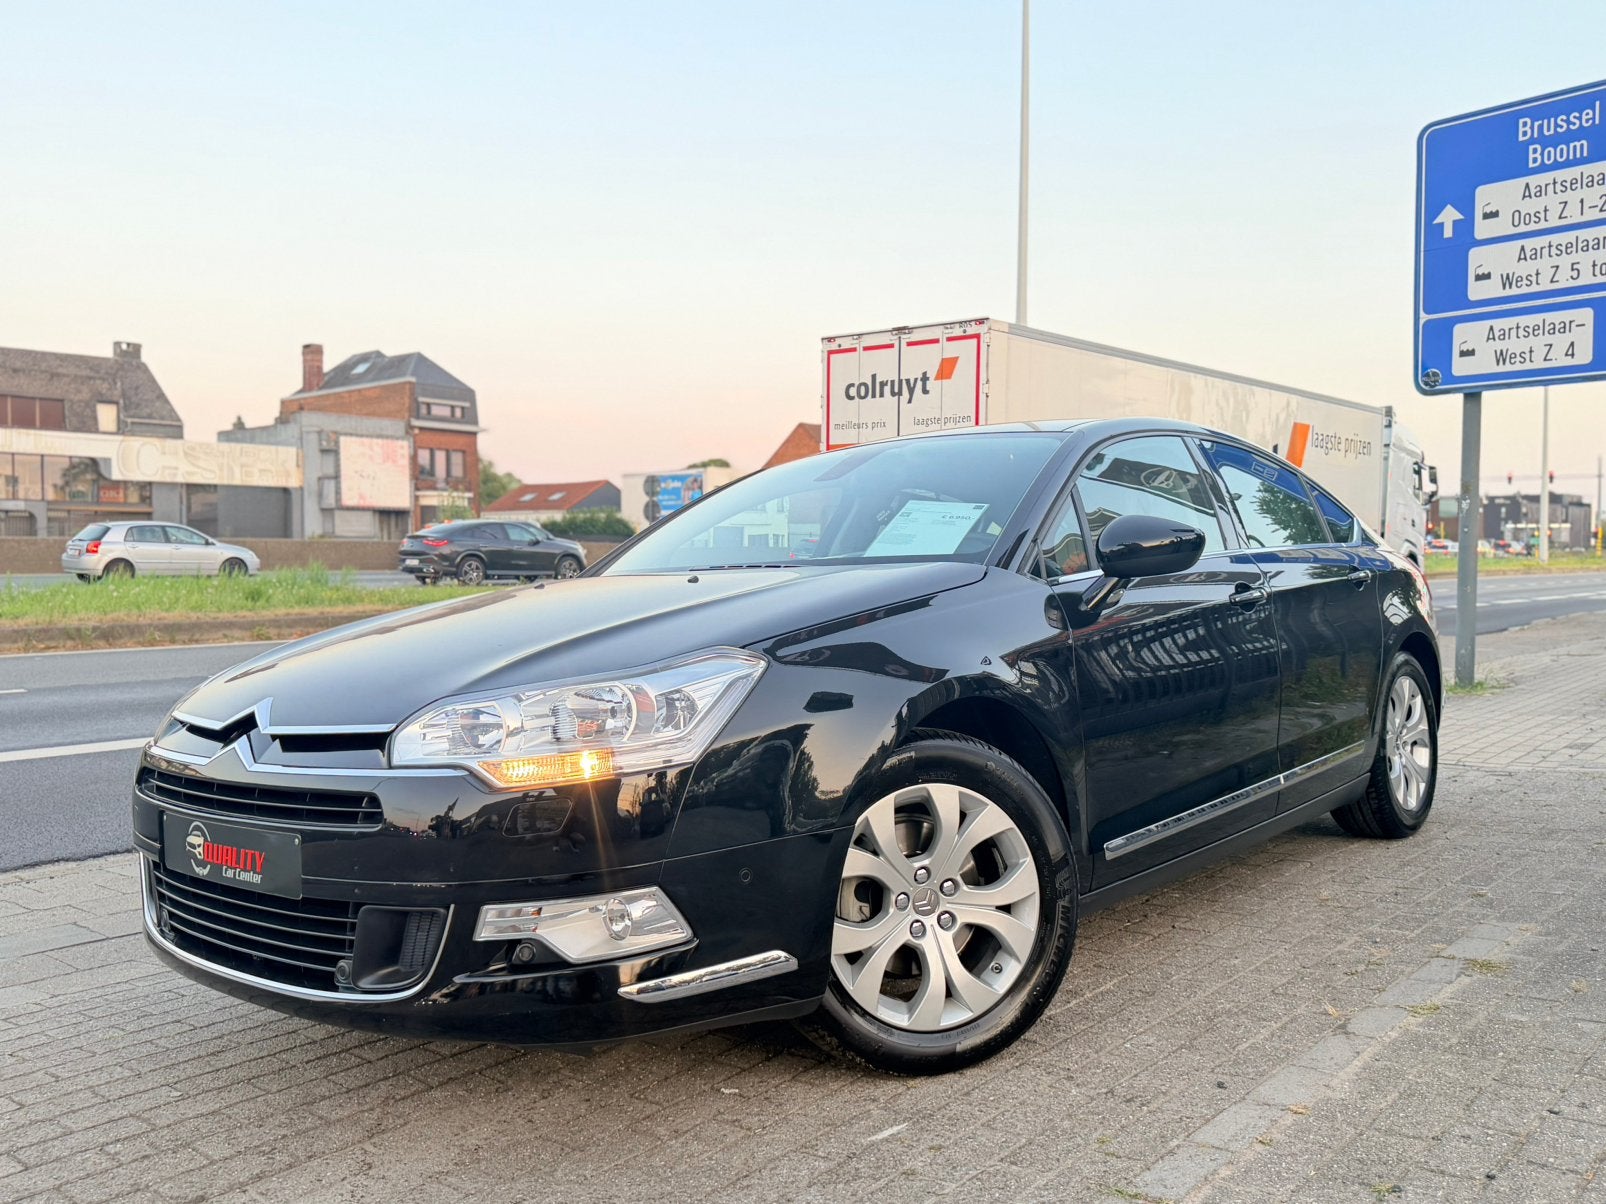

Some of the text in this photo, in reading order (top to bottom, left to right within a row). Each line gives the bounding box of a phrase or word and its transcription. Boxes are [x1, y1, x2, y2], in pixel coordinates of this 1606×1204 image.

[1518, 100, 1600, 141] Brussel
[1528, 139, 1588, 169] Boom
[1521, 171, 1606, 201] Aartselaa
[1511, 205, 1549, 228] Oost
[1500, 267, 1541, 291] West
[1486, 317, 1586, 343] Aartselaar-
[1494, 346, 1534, 367] West
[1564, 341, 1576, 360] 4
[844, 371, 930, 404] colruyt
[834, 418, 887, 433] meilleurs prix
[913, 413, 972, 428] laagste prijzen
[1311, 425, 1372, 459] laagste prijzen
[204, 842, 265, 873] QUALITY
[222, 866, 263, 884] Car Center
